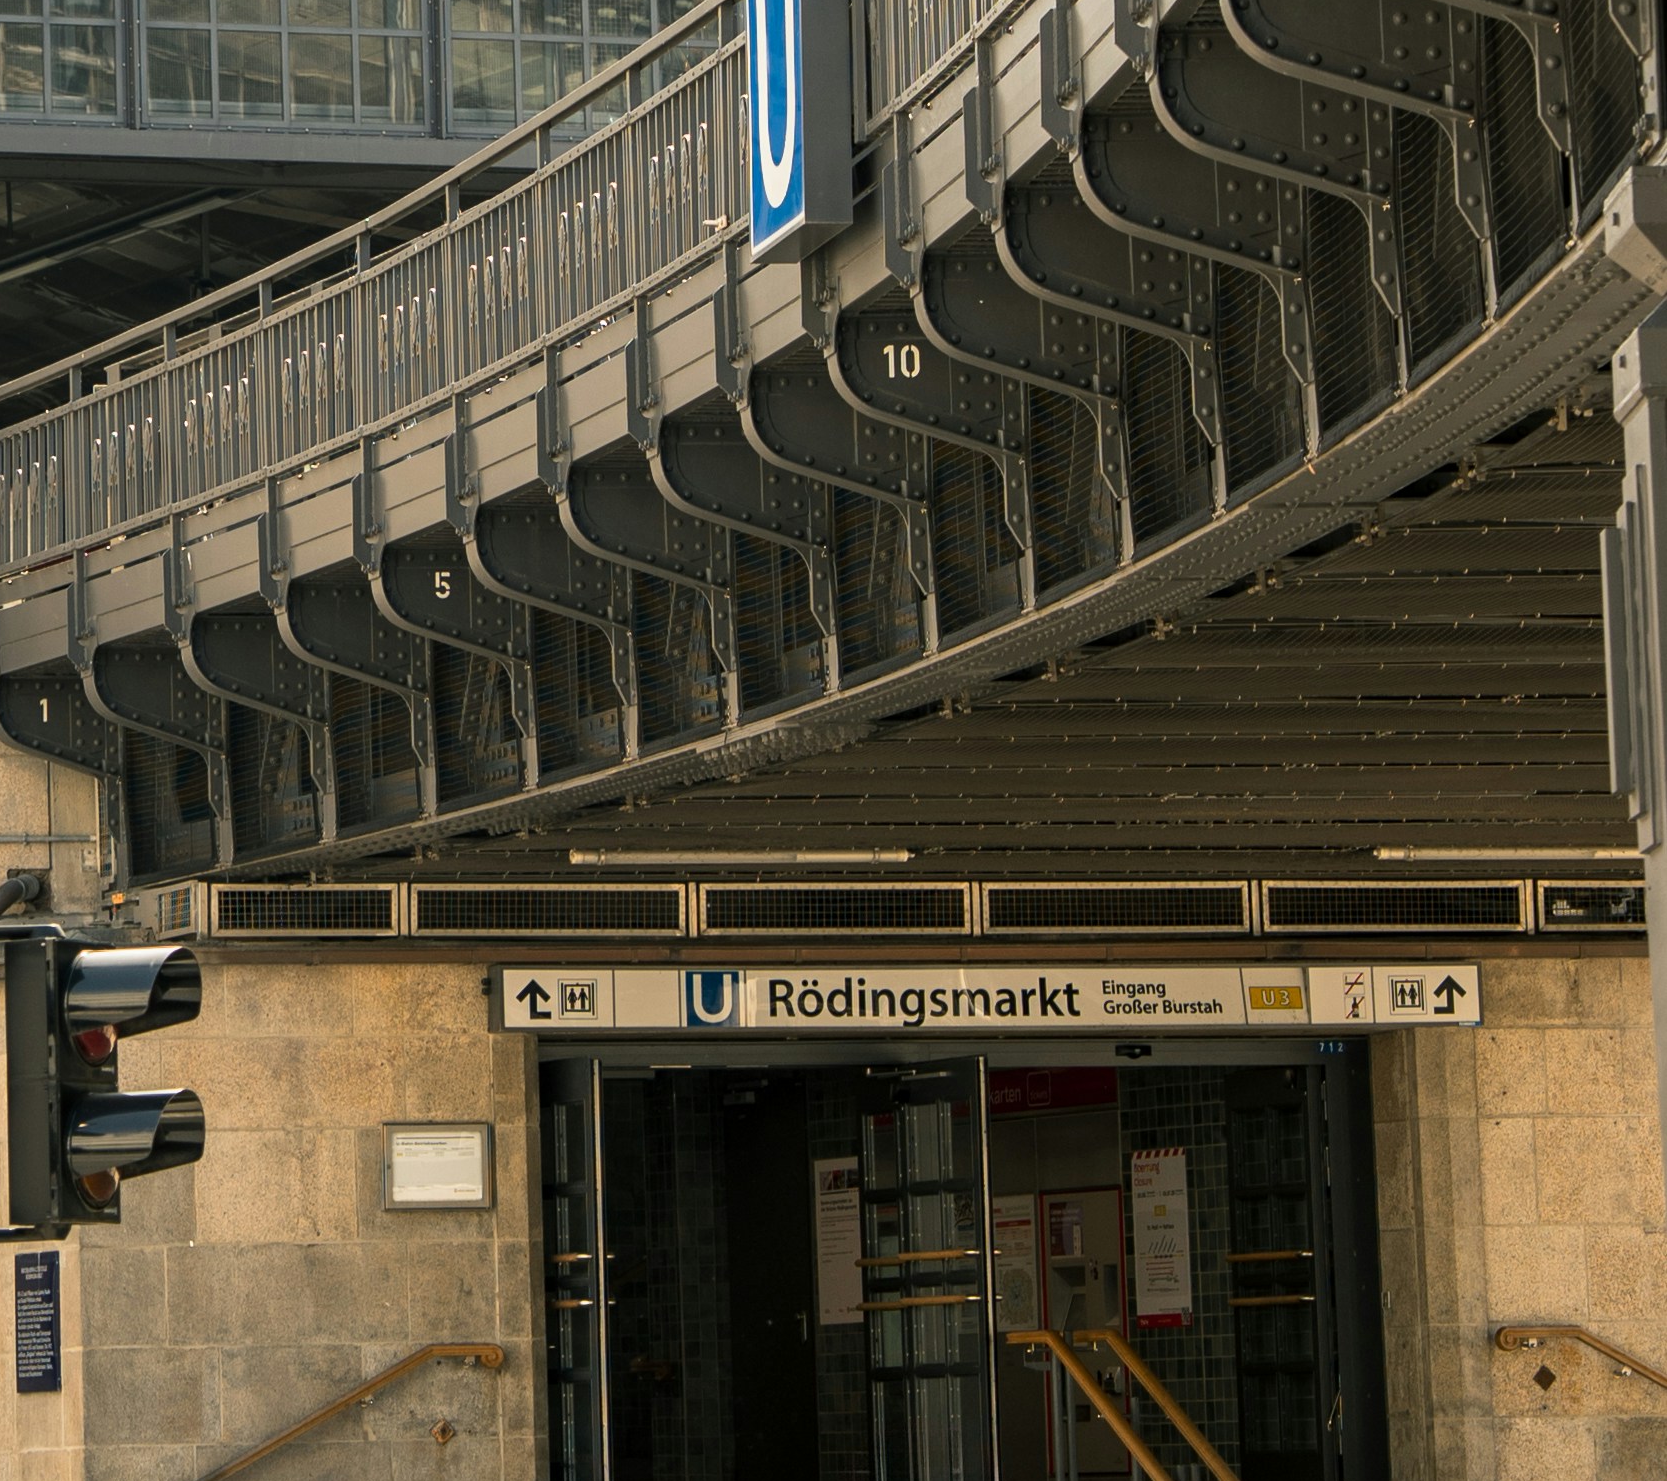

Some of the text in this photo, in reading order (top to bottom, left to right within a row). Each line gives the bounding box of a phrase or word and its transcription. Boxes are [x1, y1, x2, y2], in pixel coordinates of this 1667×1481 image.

[882, 344, 920, 379] 10
[434, 571, 451, 600] 5
[39, 698, 49, 724] 1
[692, 973, 1080, 1028] U Rödingsmarkt
[1102, 980, 1166, 998] Eingang
[1103, 999, 1223, 1015] Großer Burstah
[989, 1087, 1021, 1105] karten
